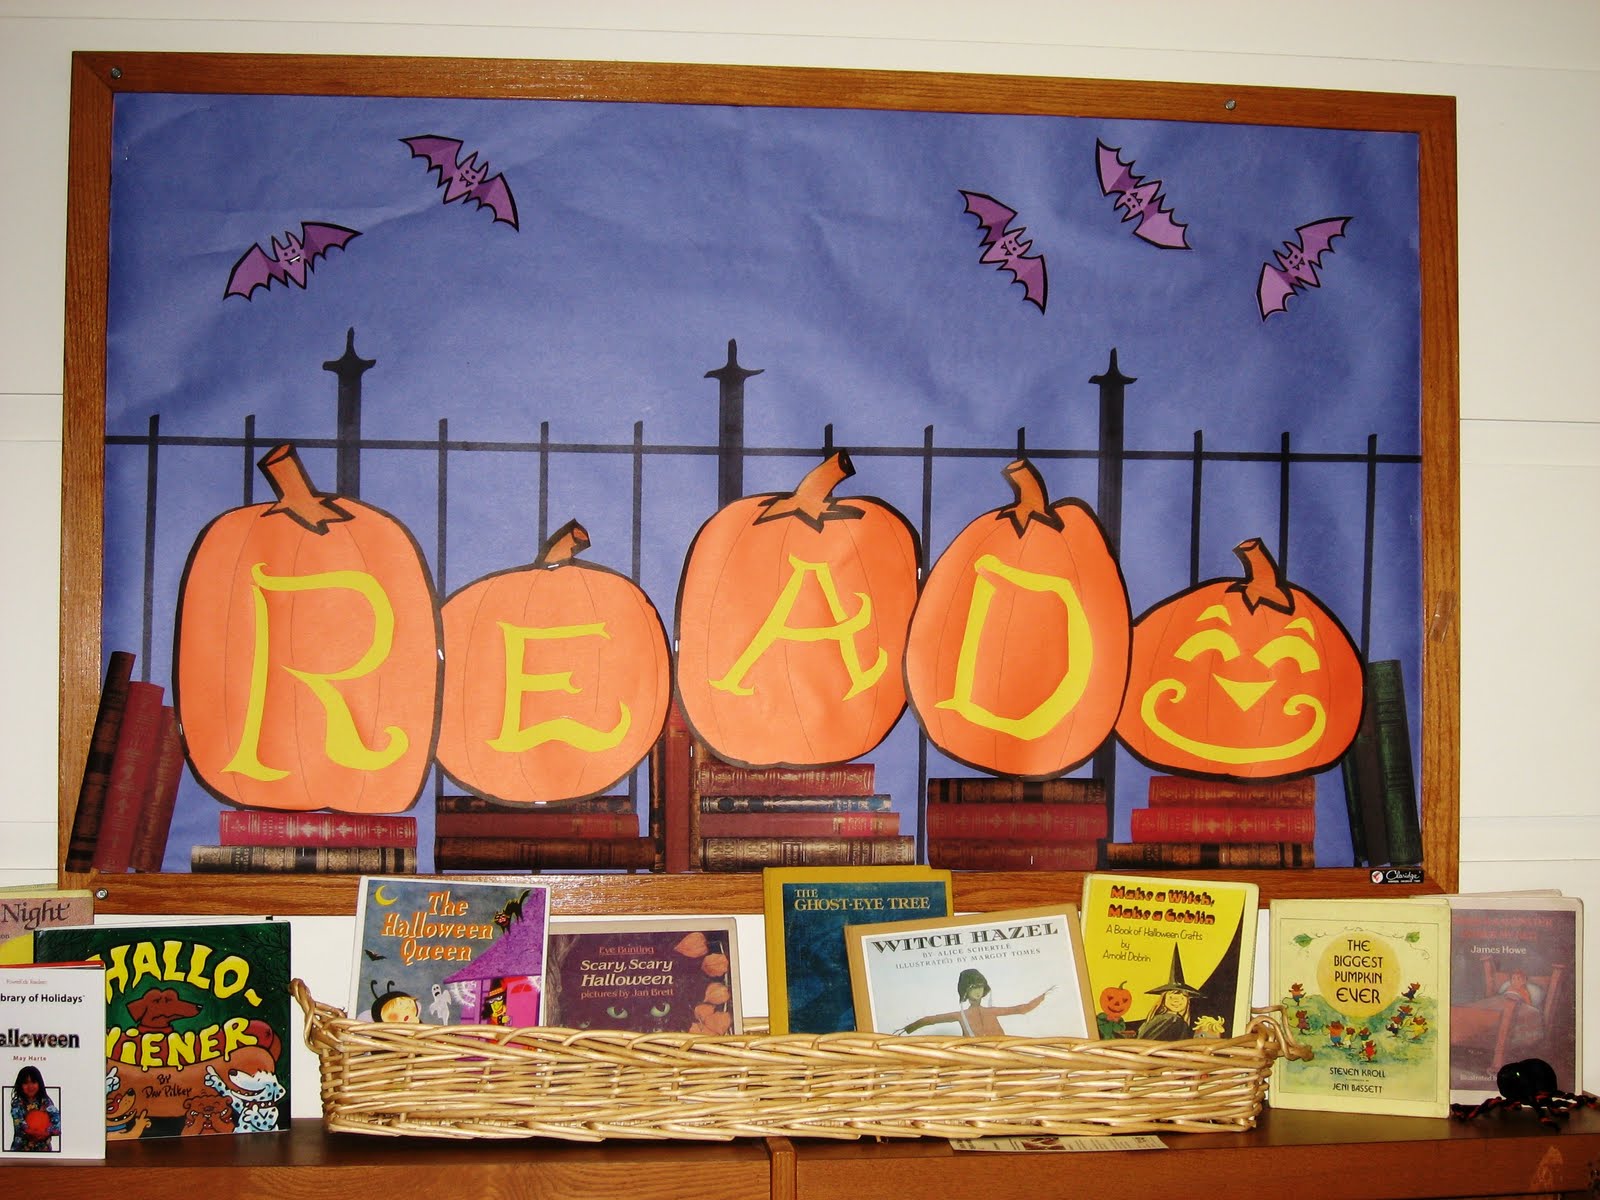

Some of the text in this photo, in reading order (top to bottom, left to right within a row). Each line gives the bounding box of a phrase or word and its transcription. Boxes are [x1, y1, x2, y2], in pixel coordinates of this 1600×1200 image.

[794, 888, 818, 899] THE
[1109, 884, 1215, 907] Make a Witch,
[426, 890, 469, 917] The
[794, 896, 931, 911] GHOST-EYE TREE
[1, 899, 71, 931] Night
[1107, 903, 1216, 926] Make a Goblin
[380, 912, 495, 940] Halloween
[1106, 925, 1203, 941] A Book of Halloween Crafts
[870, 922, 1060, 954] WITCH HAZEL
[1121, 939, 1130, 951] by
[399, 938, 473, 966] Queen
[599, 945, 654, 955] Eve Bunting
[922, 942, 1012, 959] BY ALICE SCHERTLE
[1347, 939, 1371, 952] THE
[1470, 945, 1527, 955] James Howe
[895, 947, 1041, 970] ILLUSTRATED BY MARGOT TOMES
[1102, 951, 1151, 963] Arnold Dobrin
[1333, 955, 1384, 969] BIGGEST
[580, 959, 673, 973] Scary, Scary
[581, 973, 674, 987] Halloween
[1334, 970, 1384, 985] PUMPKIN
[28, 993, 39, 1003] of
[41, 994, 83, 1005] Holidays
[581, 988, 674, 1000] pictures by Jan Brett
[1336, 987, 1381, 1005] EVER
[13, 1055, 27, 1063] May
[1329, 1067, 1386, 1078] STEVEN KROLL
[1332, 1083, 1383, 1094] JENI BASSETT
